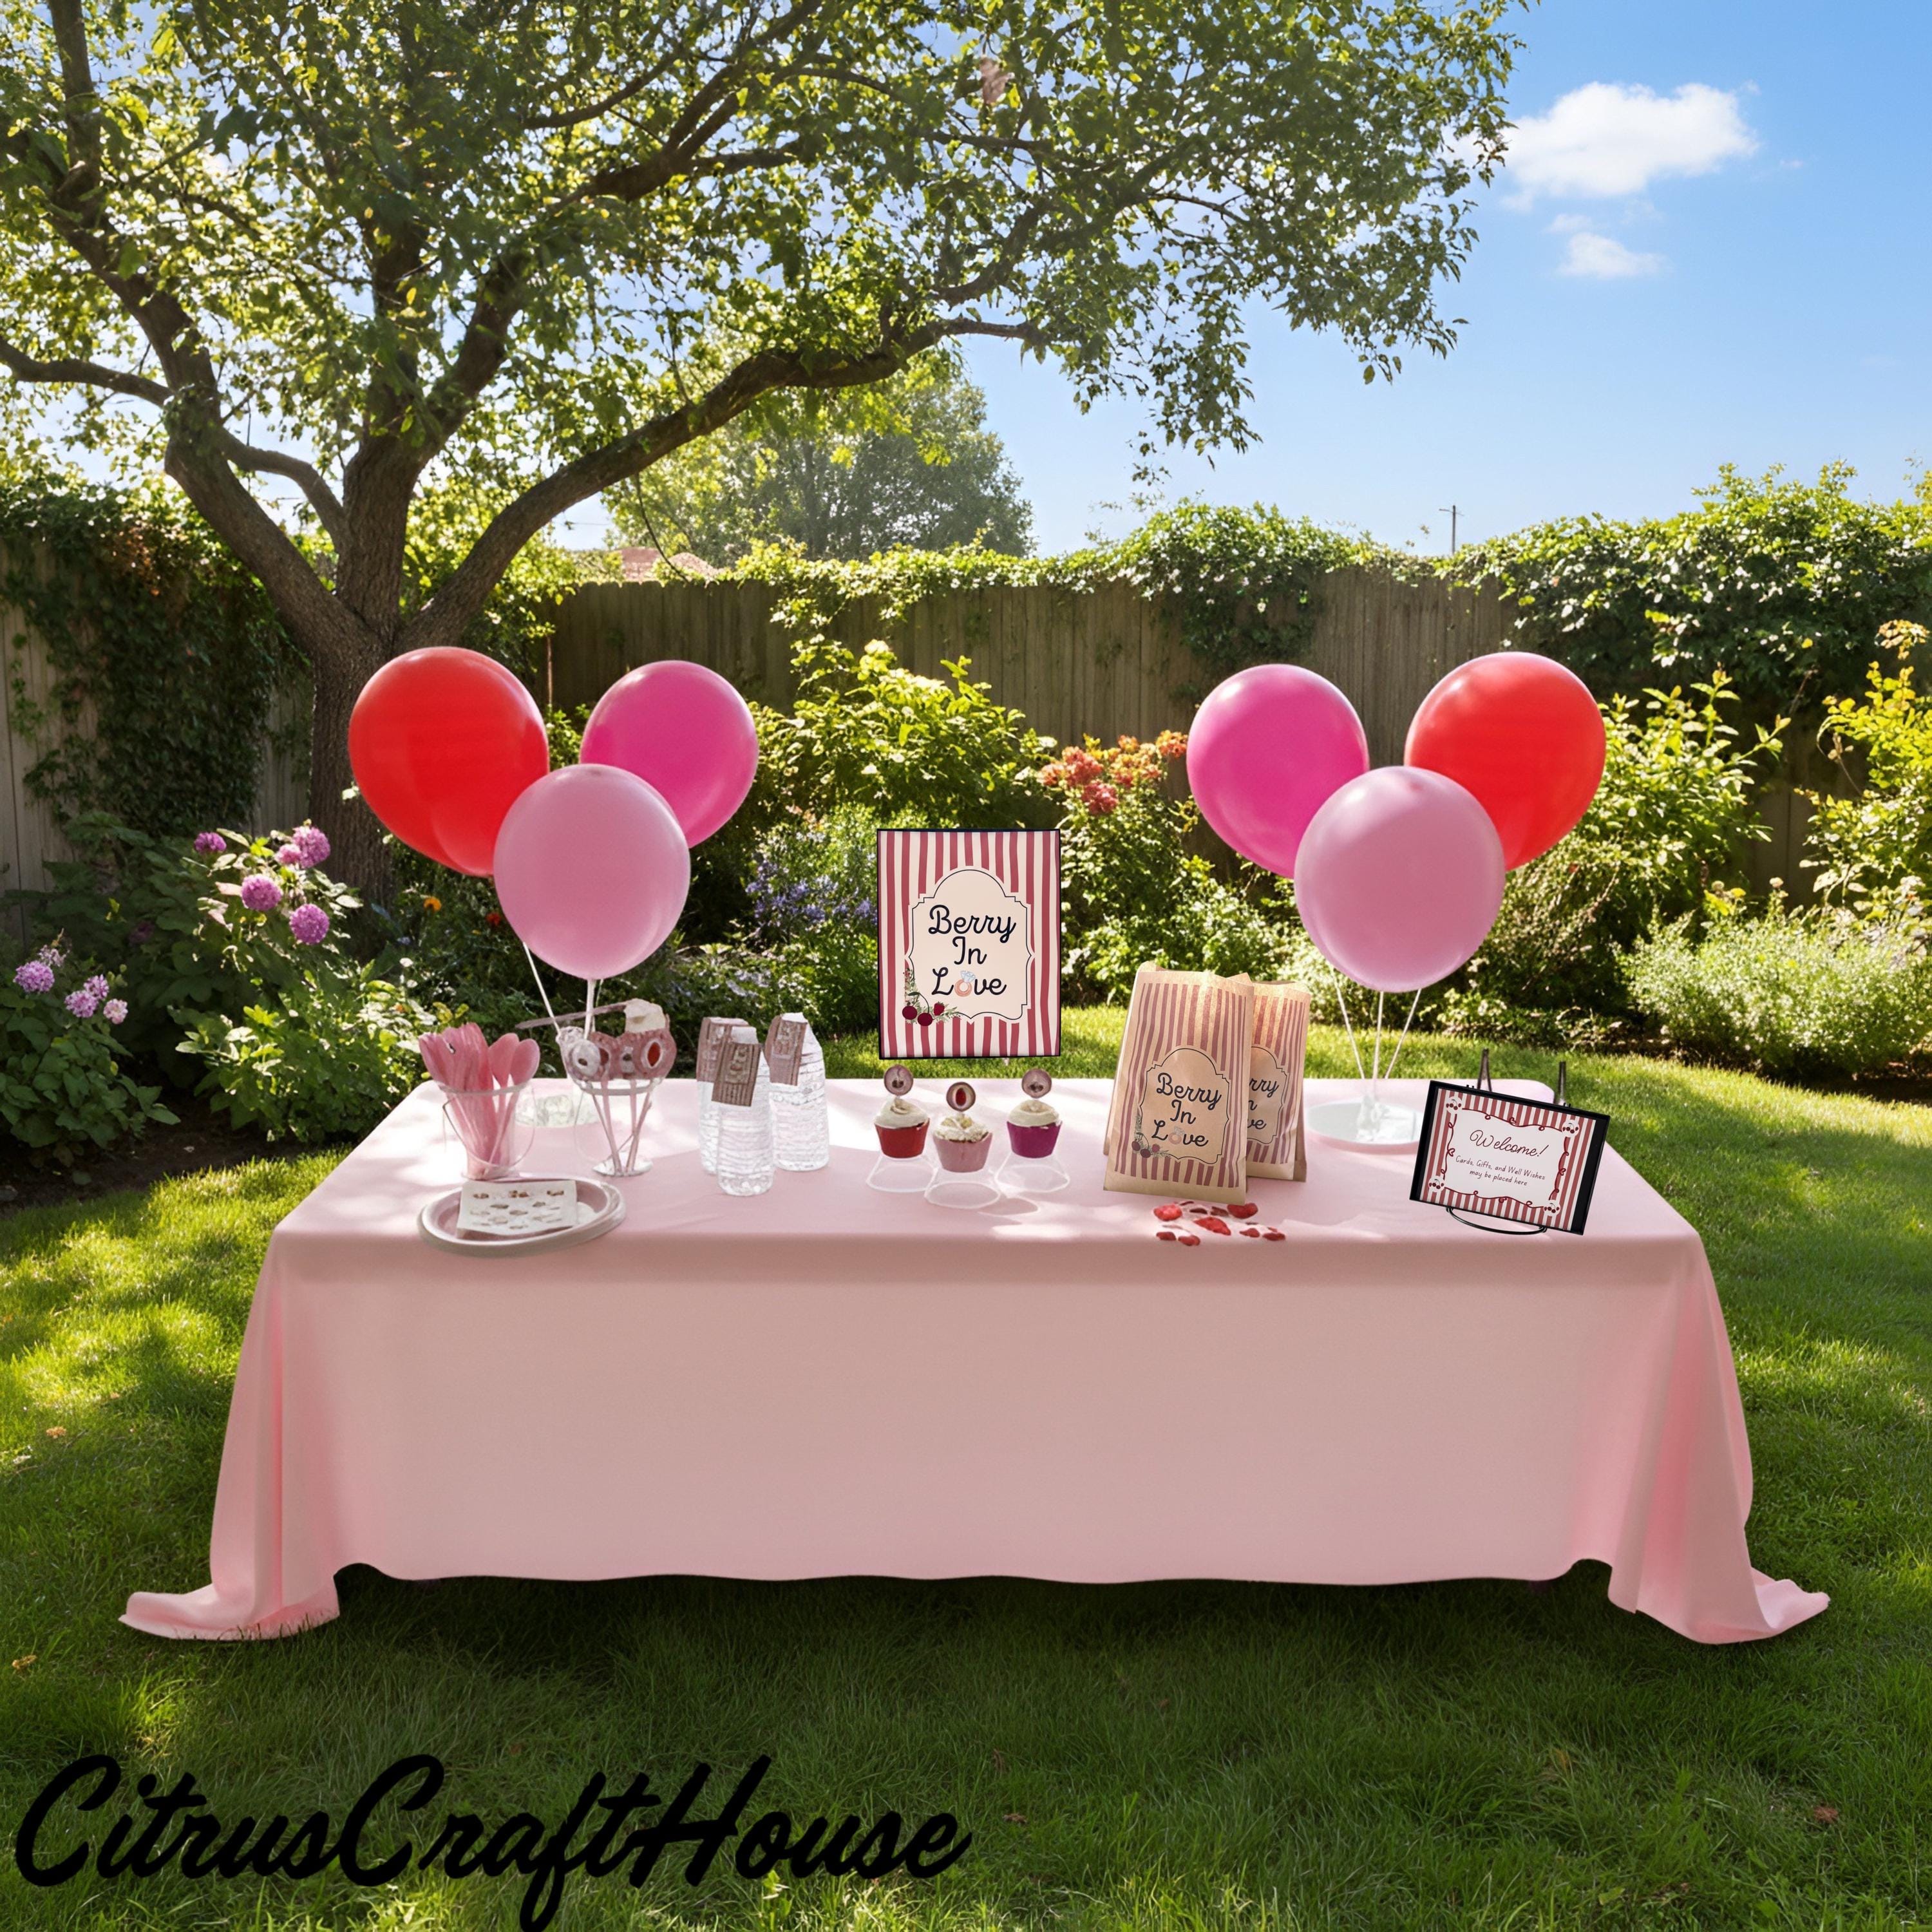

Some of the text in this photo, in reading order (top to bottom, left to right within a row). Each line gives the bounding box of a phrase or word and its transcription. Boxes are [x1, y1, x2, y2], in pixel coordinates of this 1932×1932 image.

[928, 904, 1017, 943] Berry
[952, 936, 987, 965] In
[931, 967, 1007, 997] Love
[1156, 1072, 1222, 1110] Berry
[1249, 1078, 1280, 1098] rry
[1170, 1099, 1197, 1124] In
[1470, 1130, 1549, 1157] Welcome!
[1469, 1170, 1482, 1179] may
[1492, 1173, 1513, 1182] placed
[1514, 1177, 1528, 1186] here
[1508, 1166, 1522, 1175] Well
[1523, 1169, 1546, 1180] Wishes
